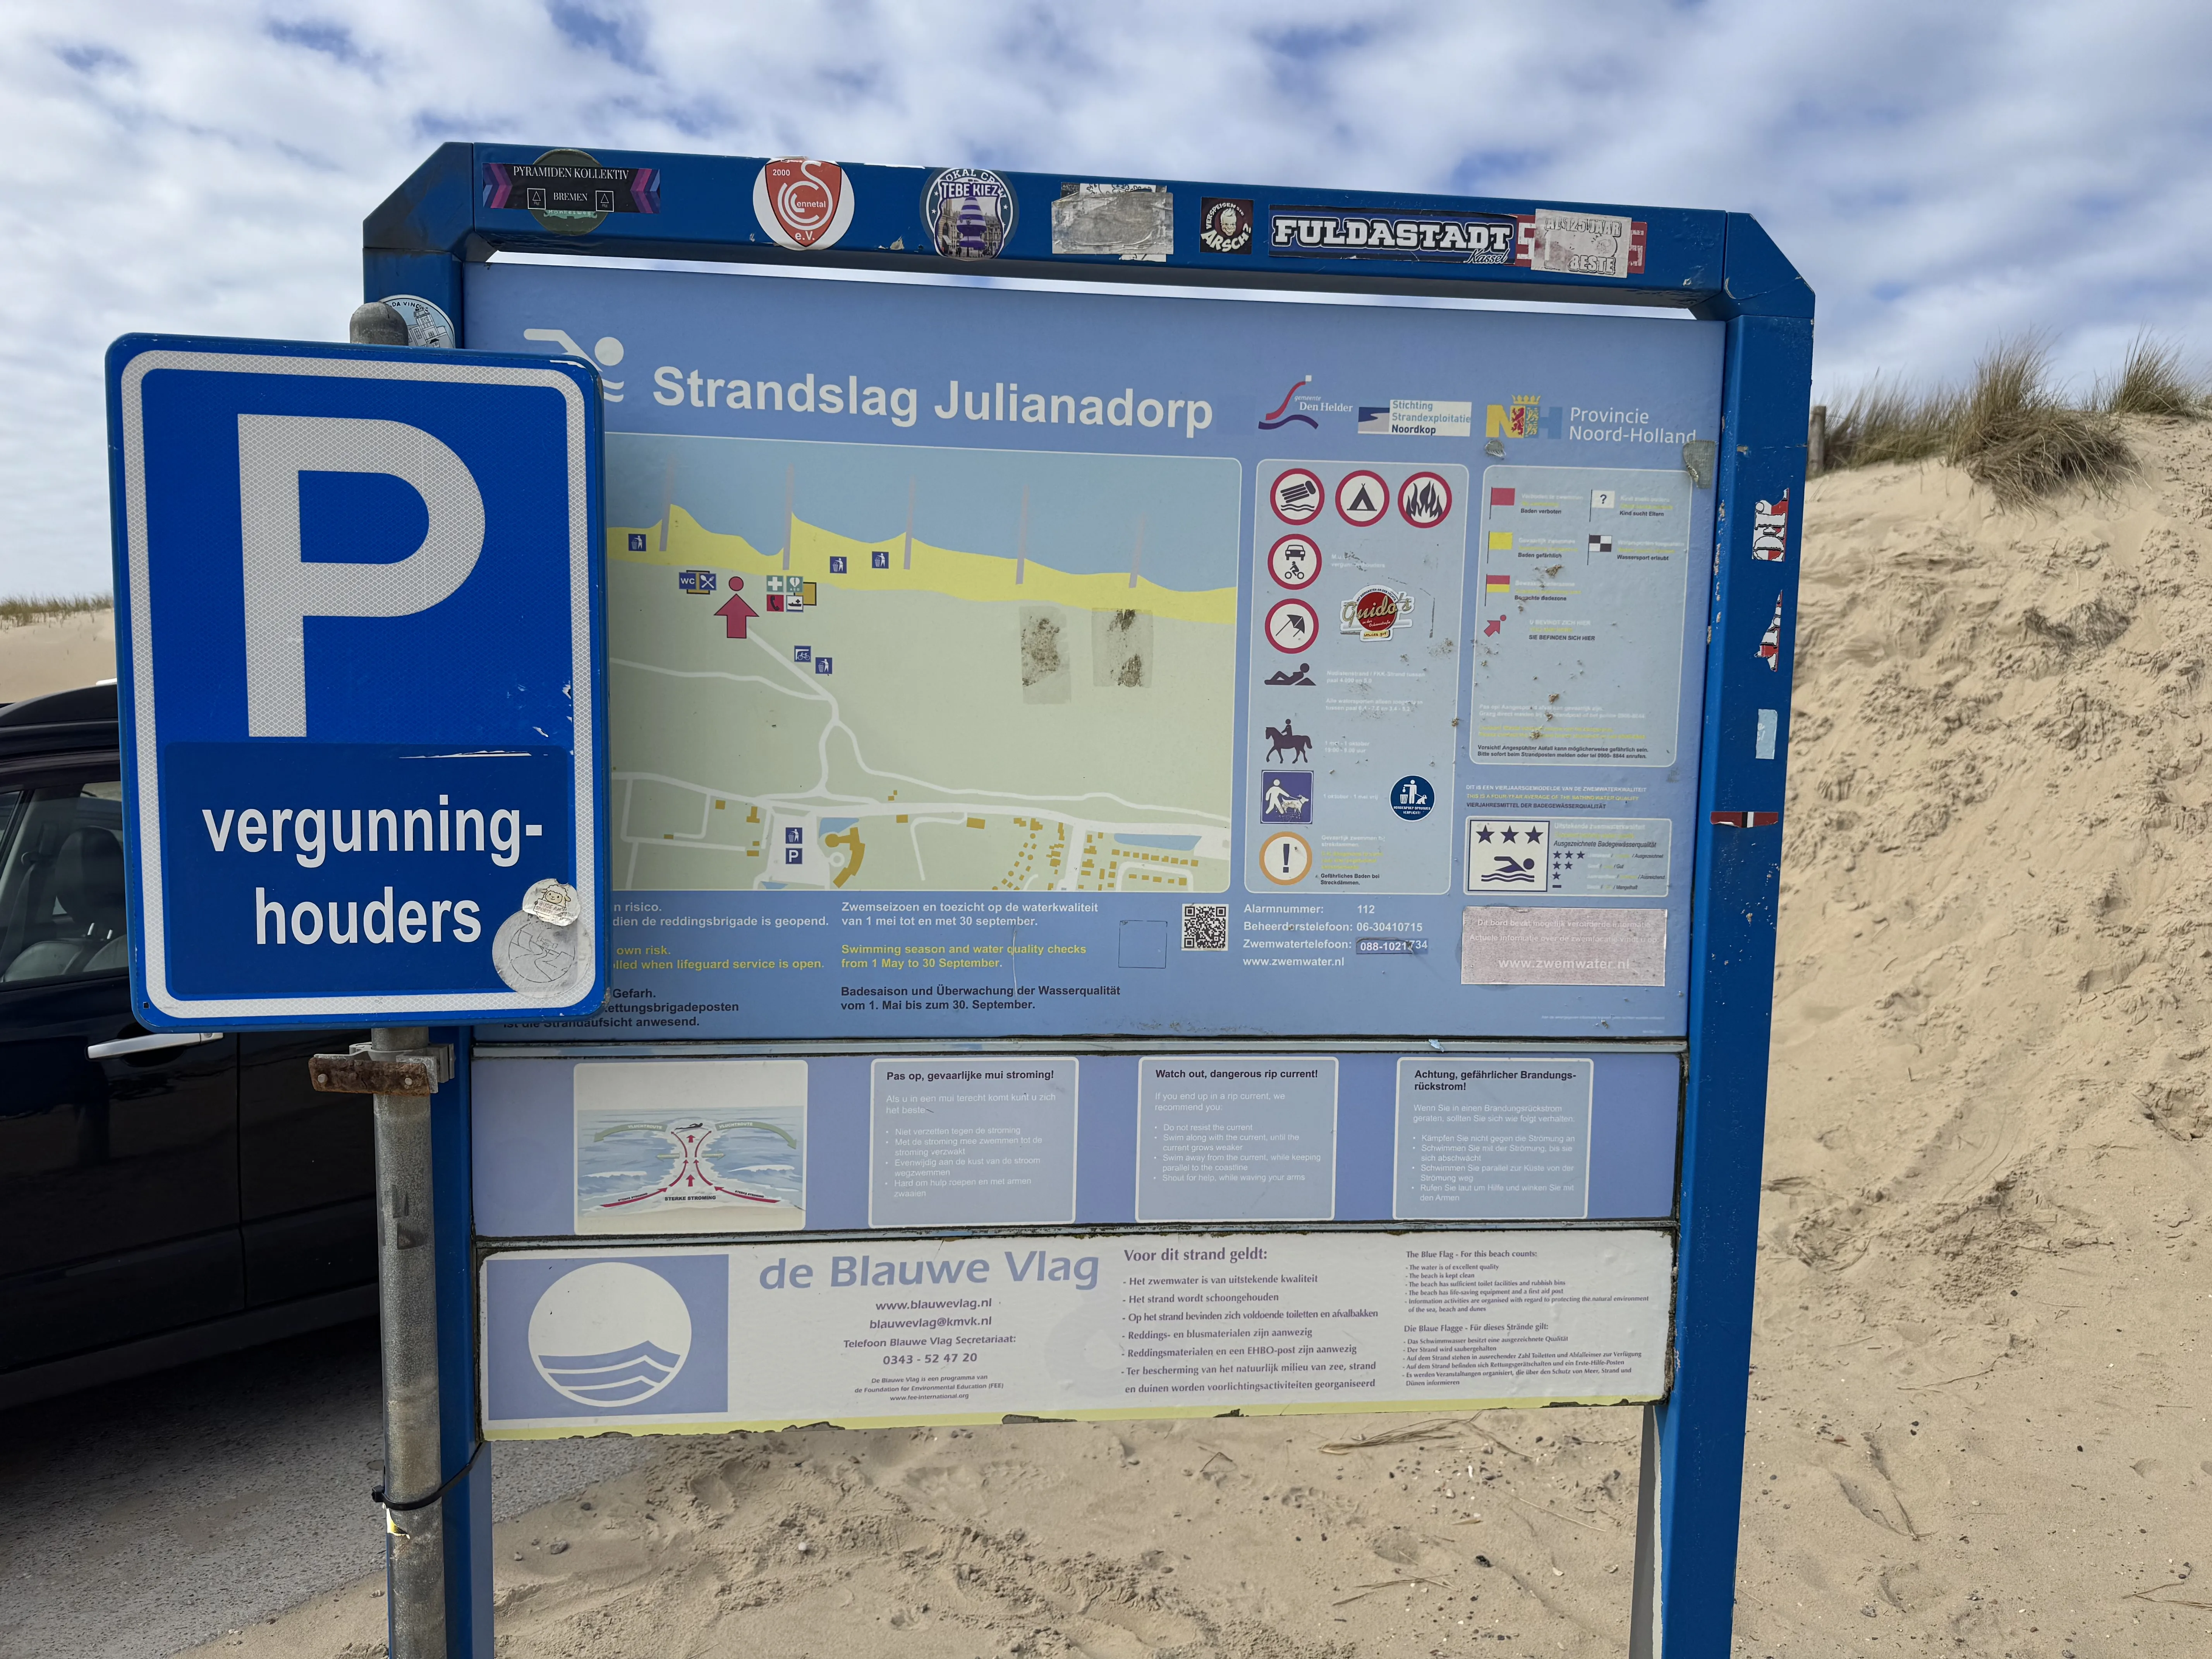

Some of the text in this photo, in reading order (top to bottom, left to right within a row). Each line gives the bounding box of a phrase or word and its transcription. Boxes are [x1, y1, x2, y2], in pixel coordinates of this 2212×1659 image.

[514, 166, 629, 179] PYRAMIDEN KOLLEKTIV
[945, 169, 976, 181] OKAL
[941, 182, 998, 198] TEBE KIEZ
[554, 192, 587, 201] BREMEN
[1206, 203, 1236, 229] VERSPEISEN
[795, 231, 814, 240] e.V.
[1274, 219, 1512, 250] FULDASTADT
[1463, 248, 1508, 264] Kassel
[1568, 254, 1616, 275] BESTE
[653, 366, 1213, 438] Strandslag Julianadorp
[1299, 402, 1353, 412] Den Helder
[1392, 400, 1433, 411] Stichting
[1392, 412, 1470, 423] Strandexploitatie
[1570, 407, 1649, 424] Provincie
[1392, 424, 1436, 436] Noordkop
[1569, 426, 1696, 444] Noord-Holland
[237, 413, 485, 738] P
[202, 794, 543, 868] vergunning-
[789, 850, 799, 862] P
[625, 902, 662, 911] risico.
[842, 902, 919, 911] Zwemseizoen
[940, 902, 984, 912] toezicht
[988, 904, 1002, 914] op
[1005, 902, 1019, 912] de
[1022, 903, 1098, 912] waterkwaliteit
[1243, 904, 1375, 914] Alarmnummer: 112
[256, 886, 482, 945] houders
[866, 916, 871, 925] 1
[876, 916, 896, 926] mei
[900, 917, 915, 926] tot
[936, 917, 956, 926] met
[960, 916, 972, 926] 30
[976, 916, 1037, 927] september.
[613, 916, 828, 928] dien de reddingsbrigade is geopend.
[1244, 921, 1422, 932] Beheerderstelefoon: 06-30410715
[1243, 939, 1352, 948] Zwemwatertelefoon:
[646, 946, 671, 955] risk.
[842, 944, 902, 957] Swimming
[949, 945, 970, 953] and
[973, 945, 1004, 953] water
[1007, 945, 1044, 956] quality
[1048, 945, 1087, 954] checks
[642, 961, 673, 969] when
[677, 960, 730, 971] lifeguard
[733, 961, 775, 969] service
[779, 960, 788, 969] is
[792, 961, 824, 970] open.
[842, 958, 1002, 970] from 1 May to 30 September.
[1243, 957, 1344, 966] www.zwemwater.nl
[1498, 959, 1630, 969] www.zwemwater.nl
[613, 988, 656, 998] Gefarh.
[841, 984, 1120, 997] Badesaison und Überwachung der Wasserqualität
[605, 1002, 738, 1014] ettungsbrigadeposten
[869, 1000, 878, 1010] 1.
[883, 1000, 902, 1010] Mai
[905, 1000, 922, 1010] bis
[953, 1000, 968, 1009] 30.
[972, 1000, 1035, 1011] September.
[636, 1017, 699, 1027] anwesend.
[887, 1070, 1054, 1082] Pas op, gevaarlijke mui stroming!
[1156, 1070, 1317, 1080] Watch out, dangerous rip current!
[1414, 1070, 1576, 1081] Achtung, gefährlicher Brandungs-
[1415, 1082, 1466, 1091] rückstrom!
[1124, 1247, 1267, 1263] Voor dit strand geldt:
[1439, 1250, 1453, 1259] Flag
[759, 1250, 1099, 1290] de Blauwe Vlag
[876, 1298, 992, 1310] www.blauwevlag.nl
[870, 1316, 992, 1329] blauwevlag@kmvk.nl
[843, 1335, 1016, 1348] Telefoon Blauwe Vlag Secretariaat:
[883, 1355, 913, 1365] 0343
[925, 1354, 939, 1363] 52
[943, 1353, 958, 1362] 47
[962, 1353, 977, 1362] 20
